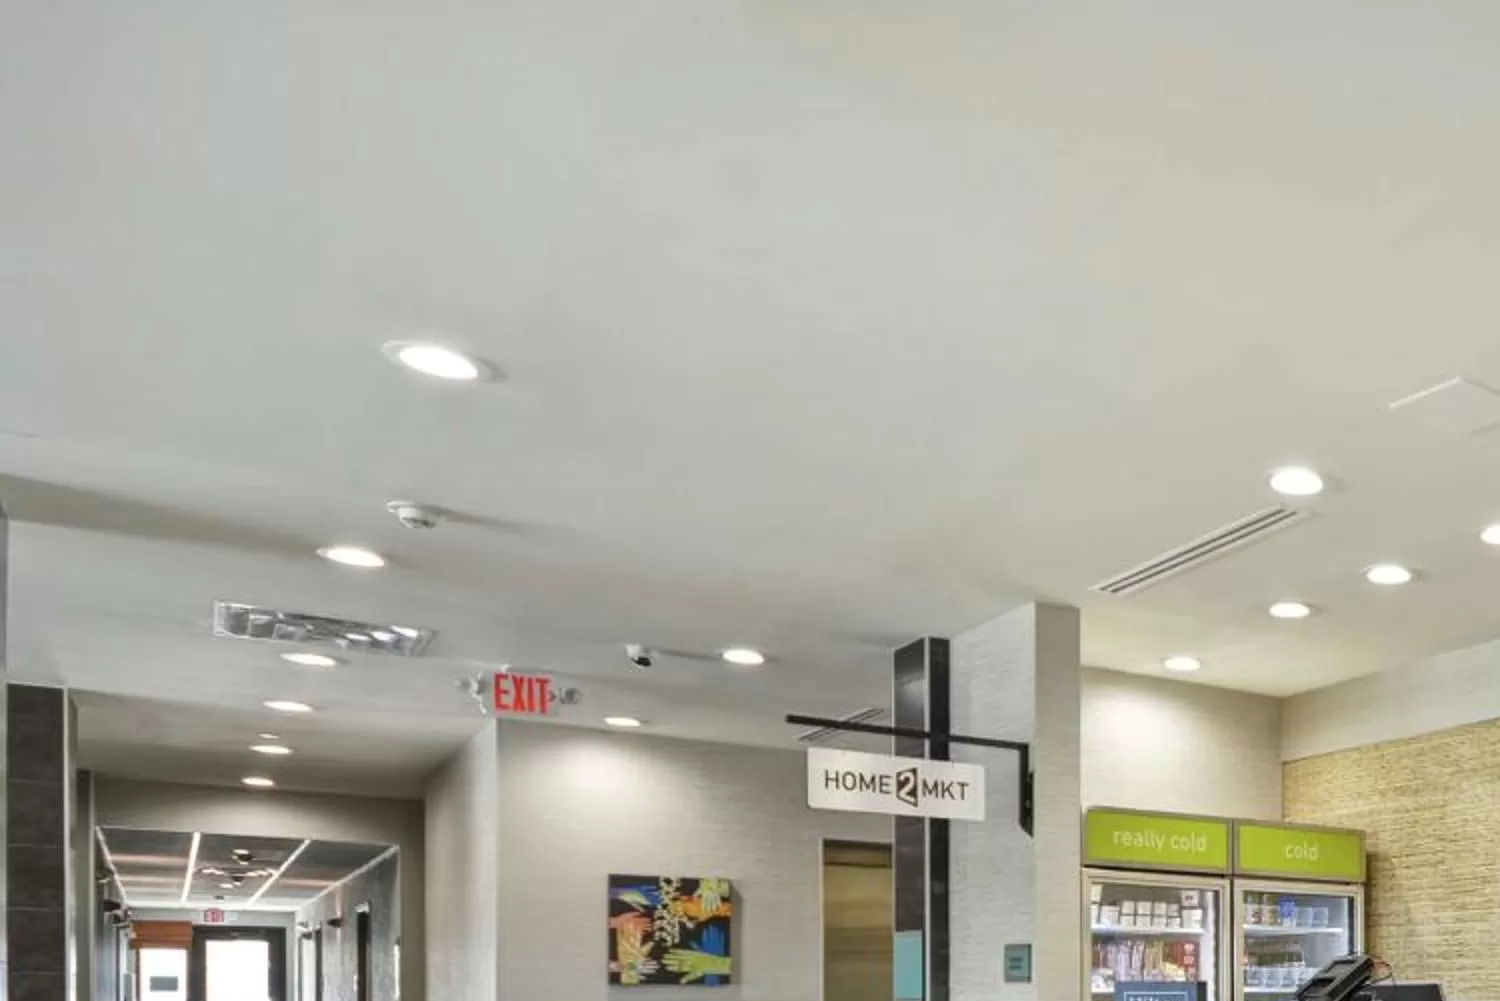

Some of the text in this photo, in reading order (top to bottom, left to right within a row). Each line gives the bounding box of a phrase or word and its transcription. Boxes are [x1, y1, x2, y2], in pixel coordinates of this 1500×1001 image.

[493, 672, 551, 714] EXIT
[1112, 829, 1208, 853] really cold
[1284, 841, 1320, 861] cold
